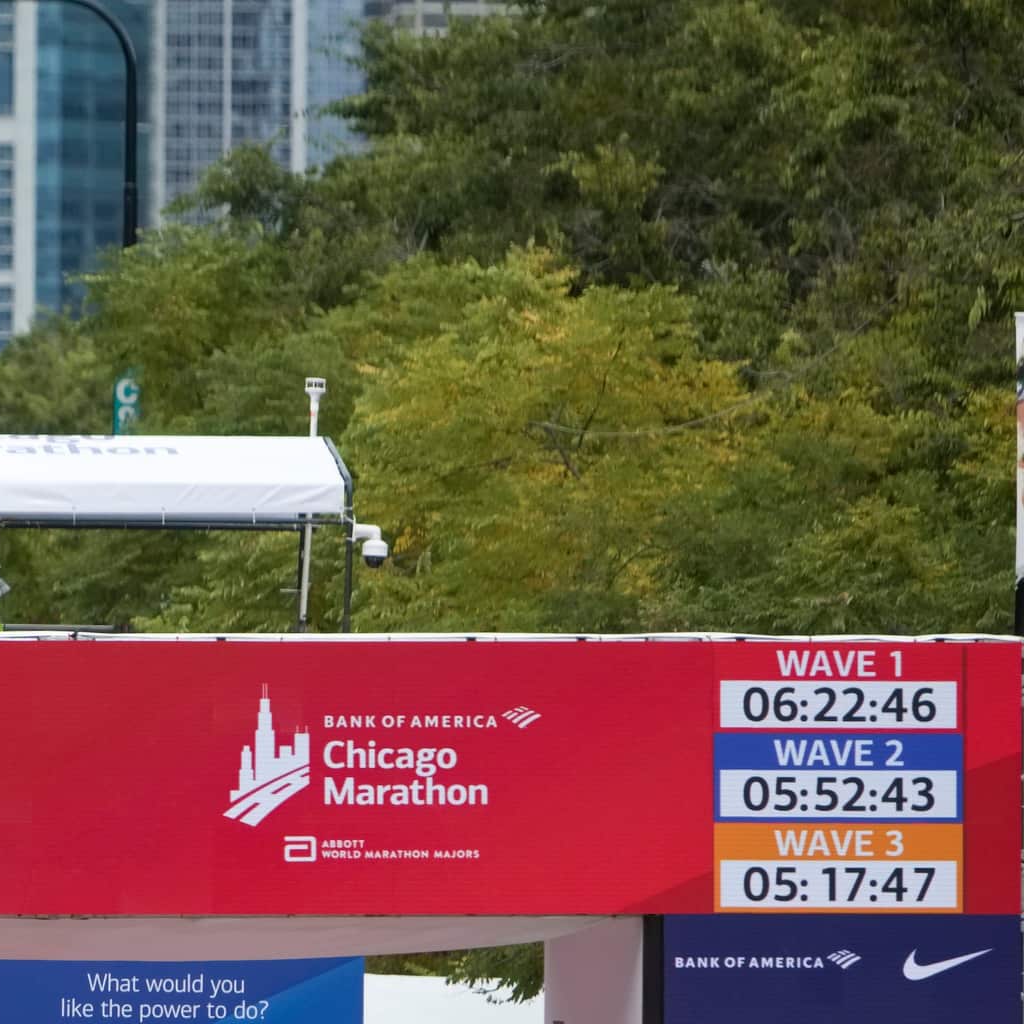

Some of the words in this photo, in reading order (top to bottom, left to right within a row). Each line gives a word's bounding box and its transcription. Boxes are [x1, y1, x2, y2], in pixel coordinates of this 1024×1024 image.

[777, 651, 876, 676] WAVE
[890, 651, 901, 676] 1
[744, 687, 936, 722] 06:22:46
[325, 716, 375, 727] BANK
[382, 716, 405, 727] OF
[411, 716, 497, 727] AMERICA
[323, 740, 457, 777] Chicago
[774, 740, 873, 766] WAVE
[886, 740, 904, 766] 2
[324, 777, 488, 806] Marathon
[744, 777, 934, 811] 05:52:43
[321, 849, 362, 859] WORLD
[364, 849, 430, 860] MARATHON
[433, 850, 480, 860] MAJORS
[322, 840, 364, 848] ABBOTT
[775, 831, 873, 856] WAVE
[886, 830, 903, 856] 3
[744, 867, 935, 901] 05:17:47
[675, 957, 719, 968] BANK
[725, 957, 744, 968] OF
[749, 957, 823, 968] AMERICA
[88, 973, 139, 992] What
[146, 974, 203, 992] would
[209, 978, 246, 999] you
[62, 998, 93, 1017] like
[101, 999, 132, 1017] the
[139, 1002, 199, 1023] power
[207, 1003, 226, 1018] to
[234, 1000, 268, 1019] do?
